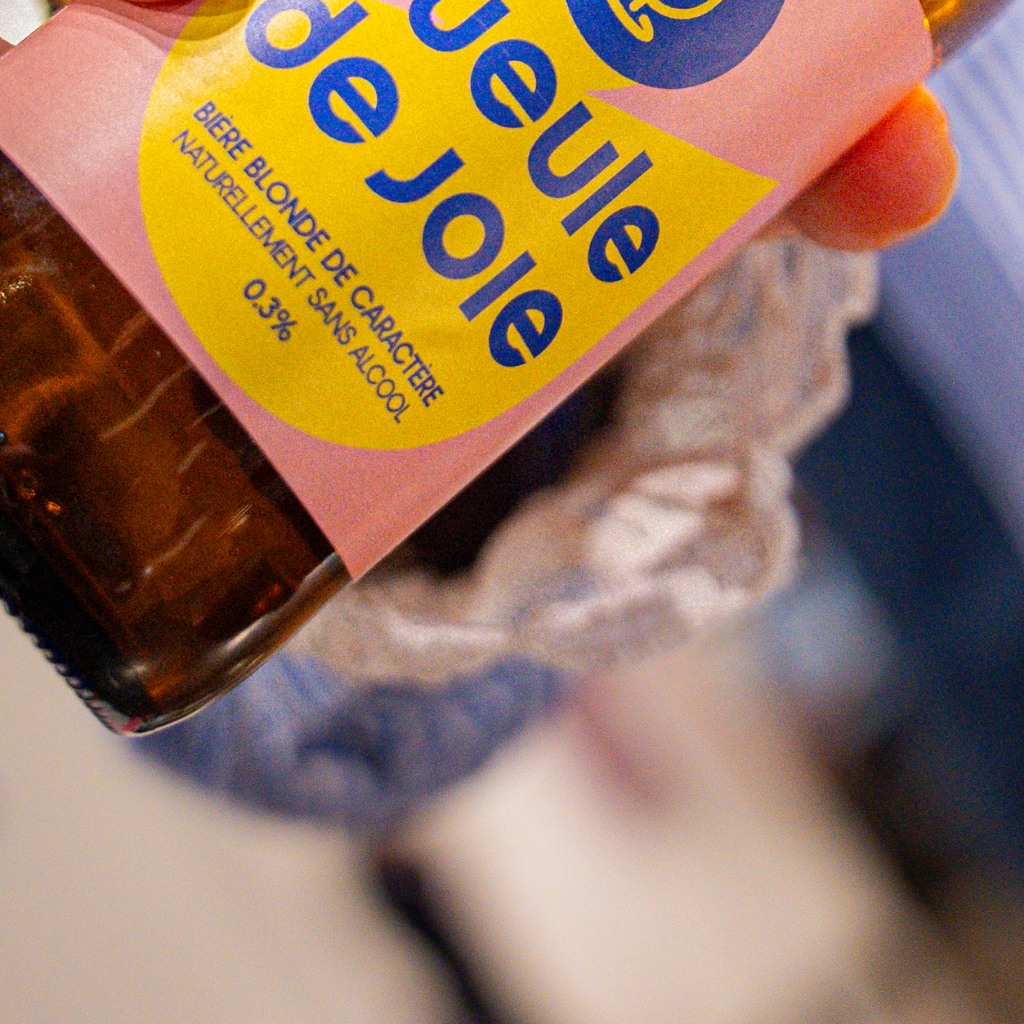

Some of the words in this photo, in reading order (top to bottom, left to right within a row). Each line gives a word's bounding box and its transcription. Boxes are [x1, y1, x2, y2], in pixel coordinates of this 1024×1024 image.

[171, 129, 316, 288] NATURELLEMENT
[307, 287, 358, 346] SANS
[348, 345, 411, 424] ALCOOL
[193, 101, 253, 161] BIÈRE
[243, 155, 331, 253] BLONDE
[320, 247, 359, 288] DE
[350, 284, 445, 407] CARACTÈRE
[243, 278, 298, 343] 0.3%
